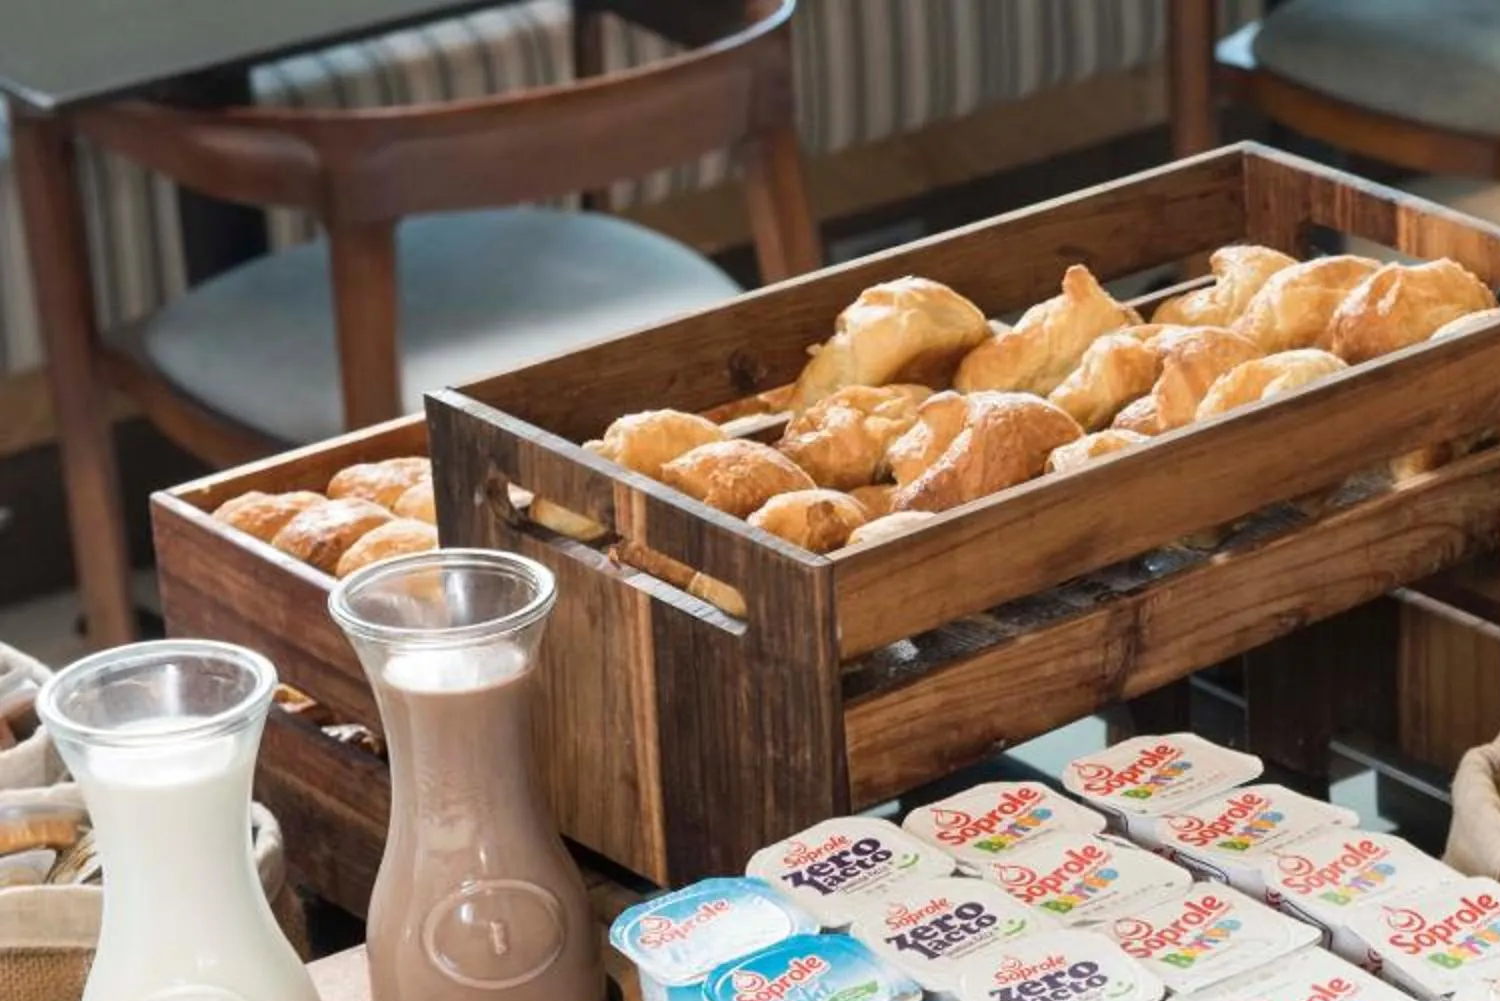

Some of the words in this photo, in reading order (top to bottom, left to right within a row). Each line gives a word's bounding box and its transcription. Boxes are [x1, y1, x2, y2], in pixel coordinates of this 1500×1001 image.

[1084, 743, 1174, 795] Soprole
[936, 788, 1037, 845] Soprole
[1178, 792, 1263, 847] Soprole
[783, 835, 850, 868] Soprole
[1282, 839, 1380, 895] Soprole
[640, 901, 729, 949] Soprole
[885, 898, 949, 930] Soprole
[1120, 896, 1224, 958] Soprole
[1389, 894, 1499, 955] Soprole
[994, 955, 1066, 985] Soprole
